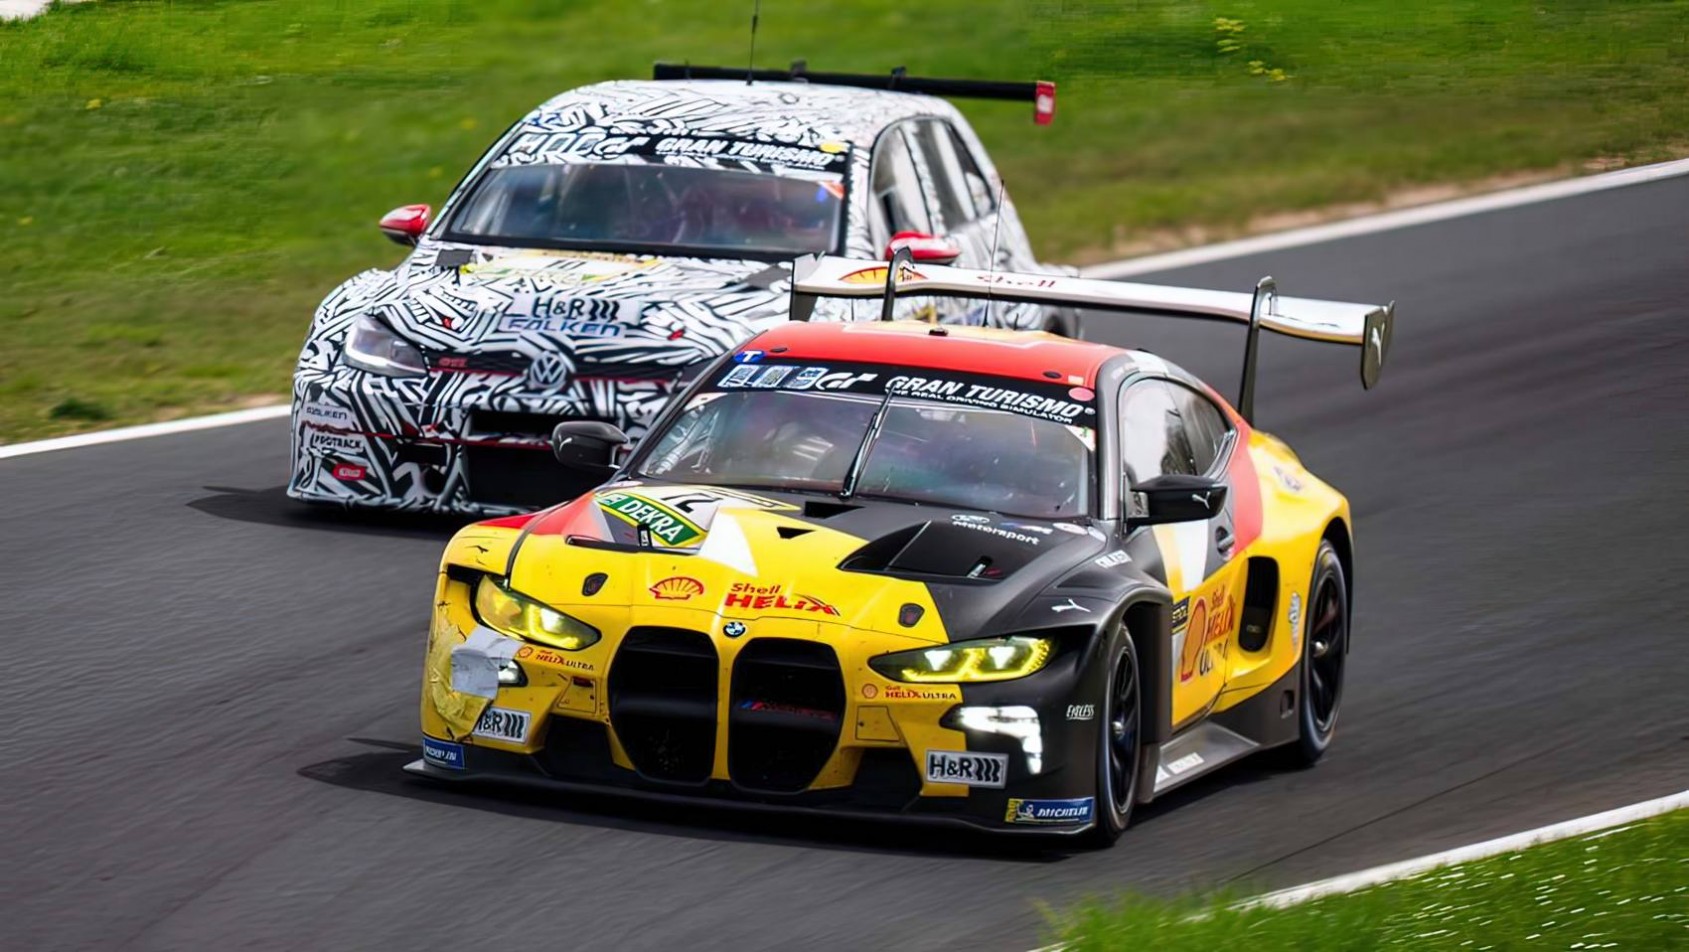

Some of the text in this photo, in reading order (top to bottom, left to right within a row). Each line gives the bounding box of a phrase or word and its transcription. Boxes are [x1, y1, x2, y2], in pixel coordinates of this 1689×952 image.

[655, 137, 728, 155] GRAN
[885, 376, 964, 395] GRAN
[965, 384, 1084, 418] TURISMO
[1000, 404, 1073, 425] SIMULATOR
[617, 499, 684, 542] DEKRA
[952, 520, 1040, 546] Motorsport
[731, 582, 781, 595] Shell
[724, 593, 838, 616] HELIX
[921, 692, 957, 700] ULTRA
[929, 754, 973, 779] H&R
